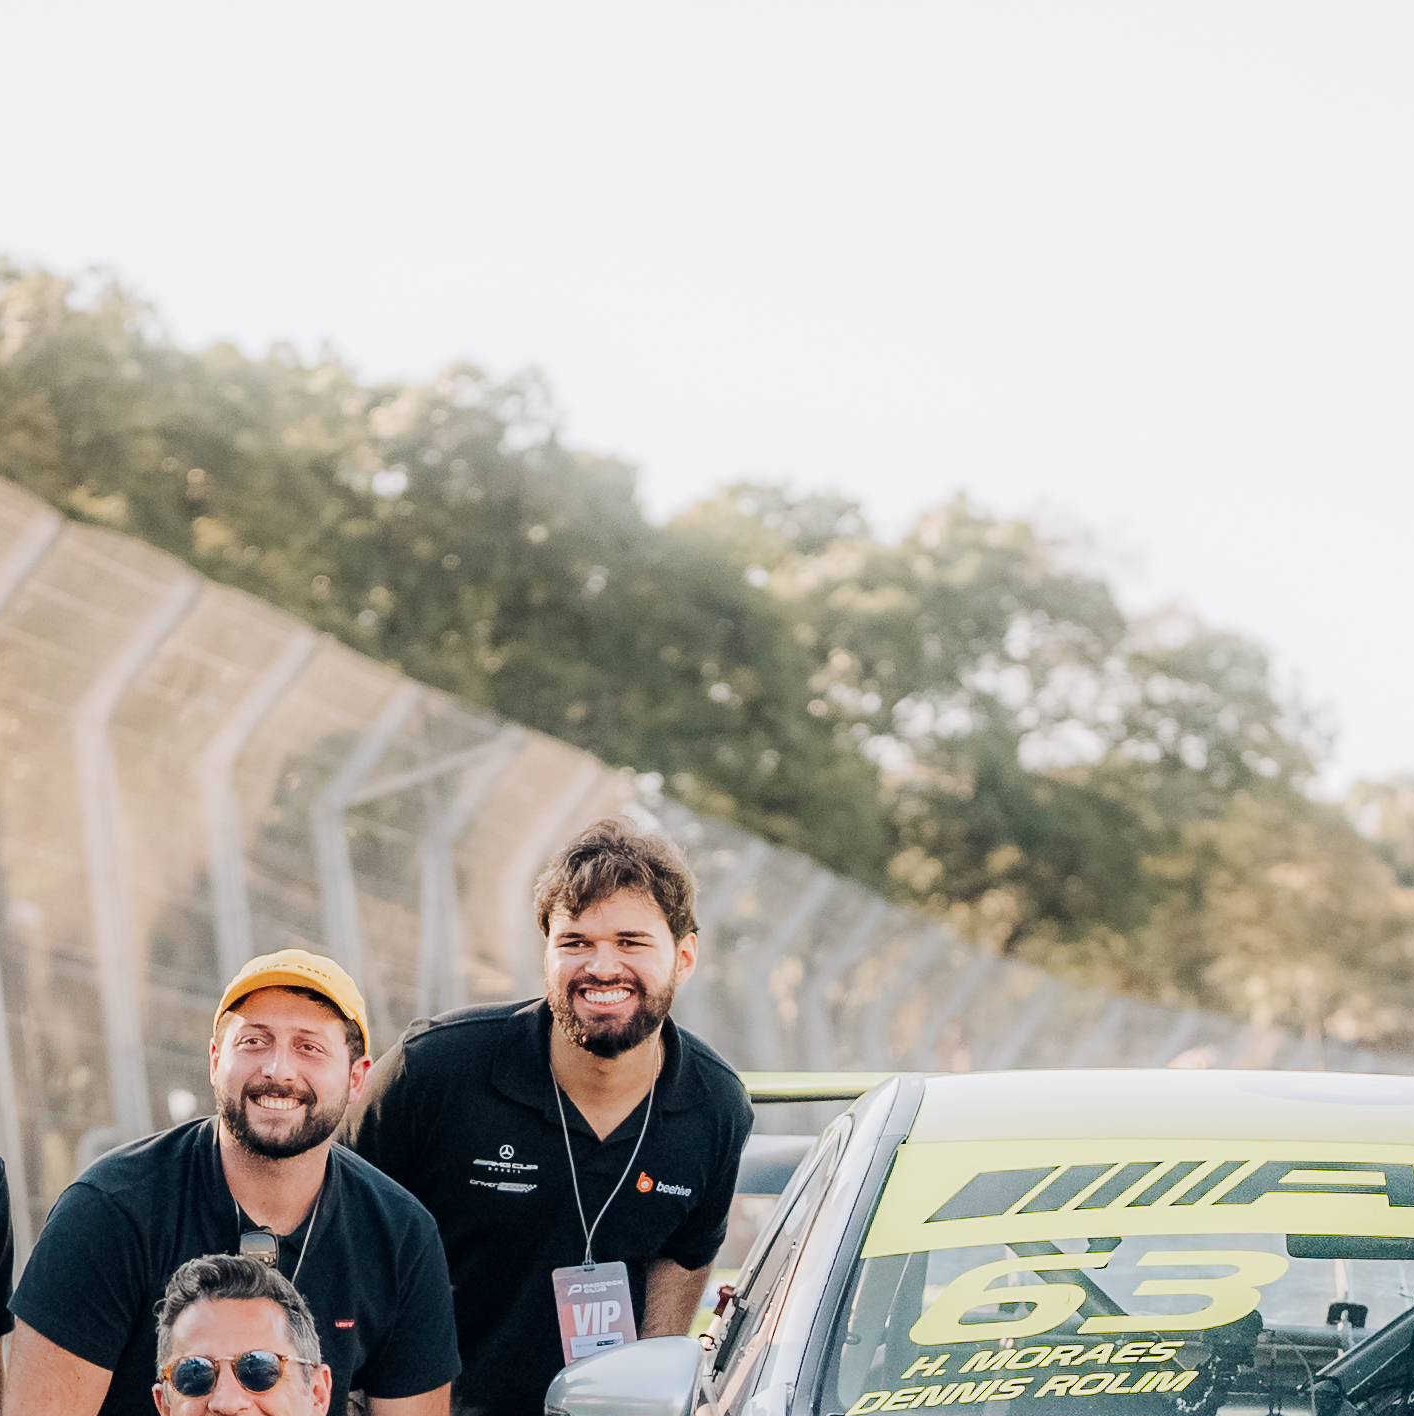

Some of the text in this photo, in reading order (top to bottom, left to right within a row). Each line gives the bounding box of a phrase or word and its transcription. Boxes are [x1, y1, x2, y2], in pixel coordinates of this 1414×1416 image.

[655, 1181, 692, 1197] beehive
[571, 1300, 622, 1336] VIP
[908, 1249, 1290, 1346] 63
[900, 1339, 1186, 1380] H. MORAES
[844, 1370, 1201, 1416] DENNIS ROLIM
